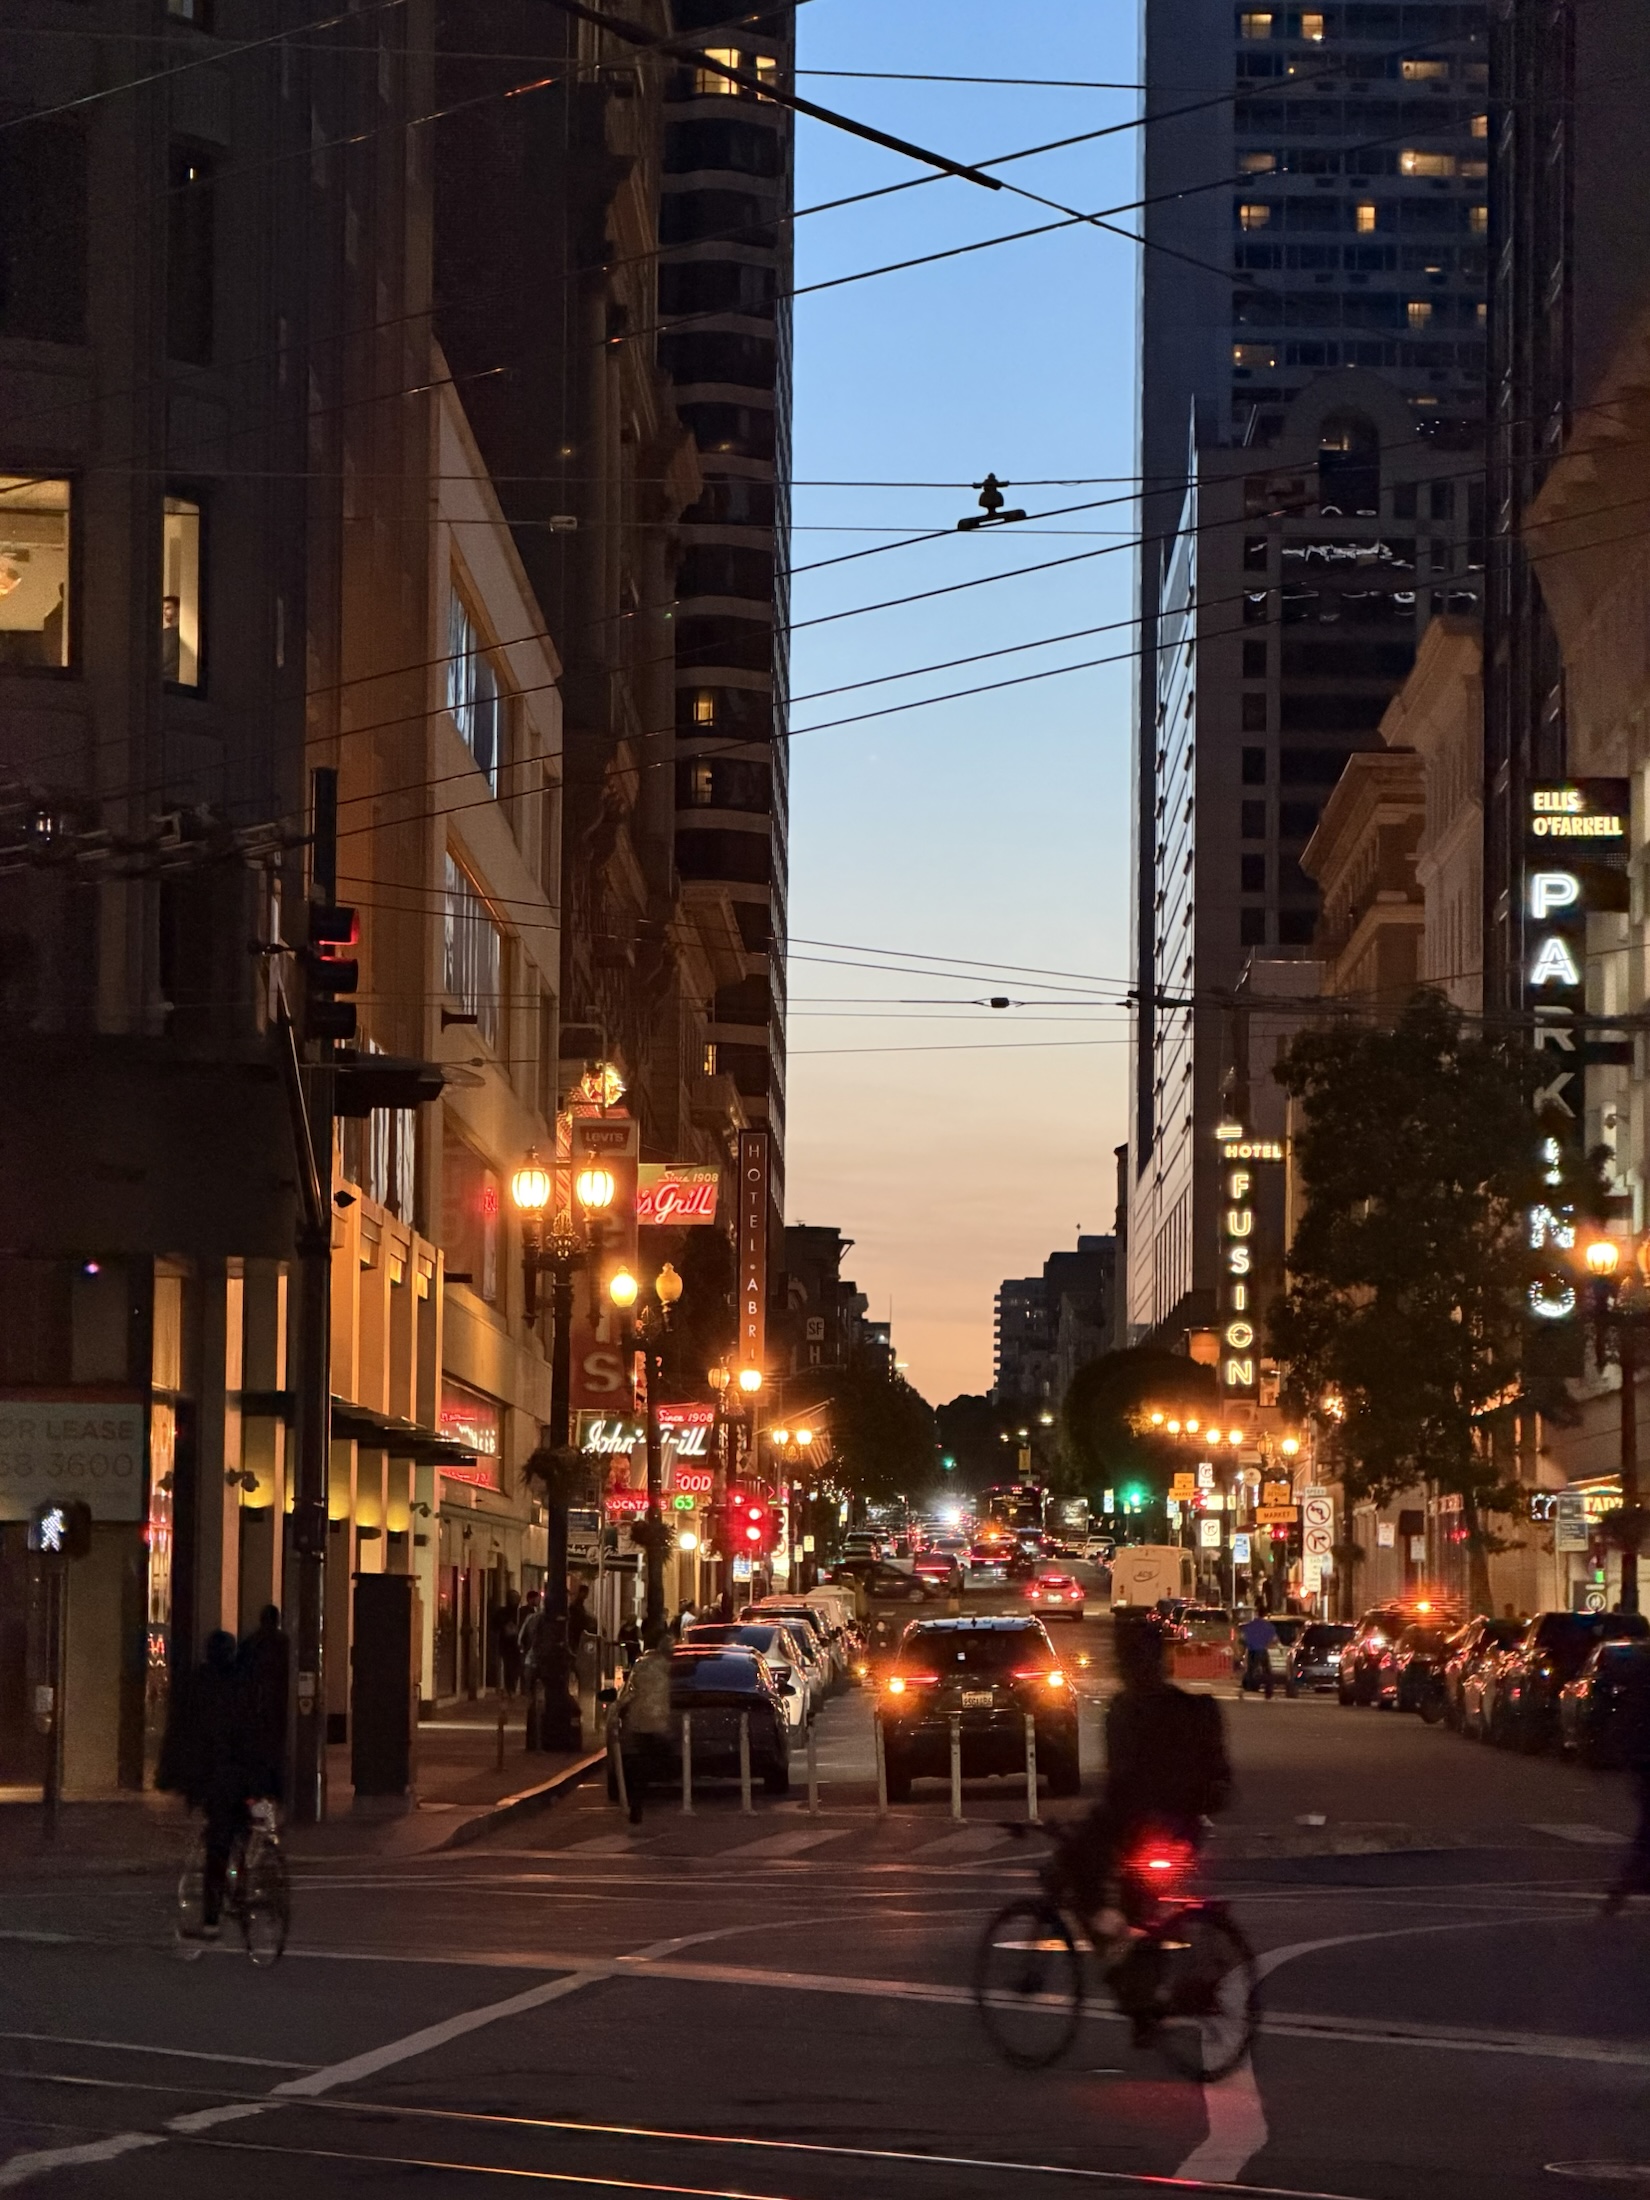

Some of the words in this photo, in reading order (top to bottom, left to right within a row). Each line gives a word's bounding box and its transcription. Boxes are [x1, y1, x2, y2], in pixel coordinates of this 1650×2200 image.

[1533, 792, 1579, 811] ELLIS
[1533, 816, 1623, 836] O'FARRELL
[1530, 873, 1580, 1318] PARKING
[1225, 1145, 1282, 1159] HOTEL
[658, 1171, 690, 1183] Since
[693, 1173, 719, 1182] 1908
[655, 1183, 713, 1224] Grill
[747, 1144, 761, 1252] HOTEL
[1227, 1174, 1253, 1386] FUSION
[746, 1278, 759, 1361] ABRI
[808, 1321, 823, 1336] SF
[659, 1410, 685, 1422] Since
[688, 1413, 714, 1422] 1908
[46, 1420, 134, 1440] LEASE
[46, 1453, 133, 1477] 3600
[606, 1500, 668, 1510] COCKTAS
[674, 1494, 695, 1510] 63
